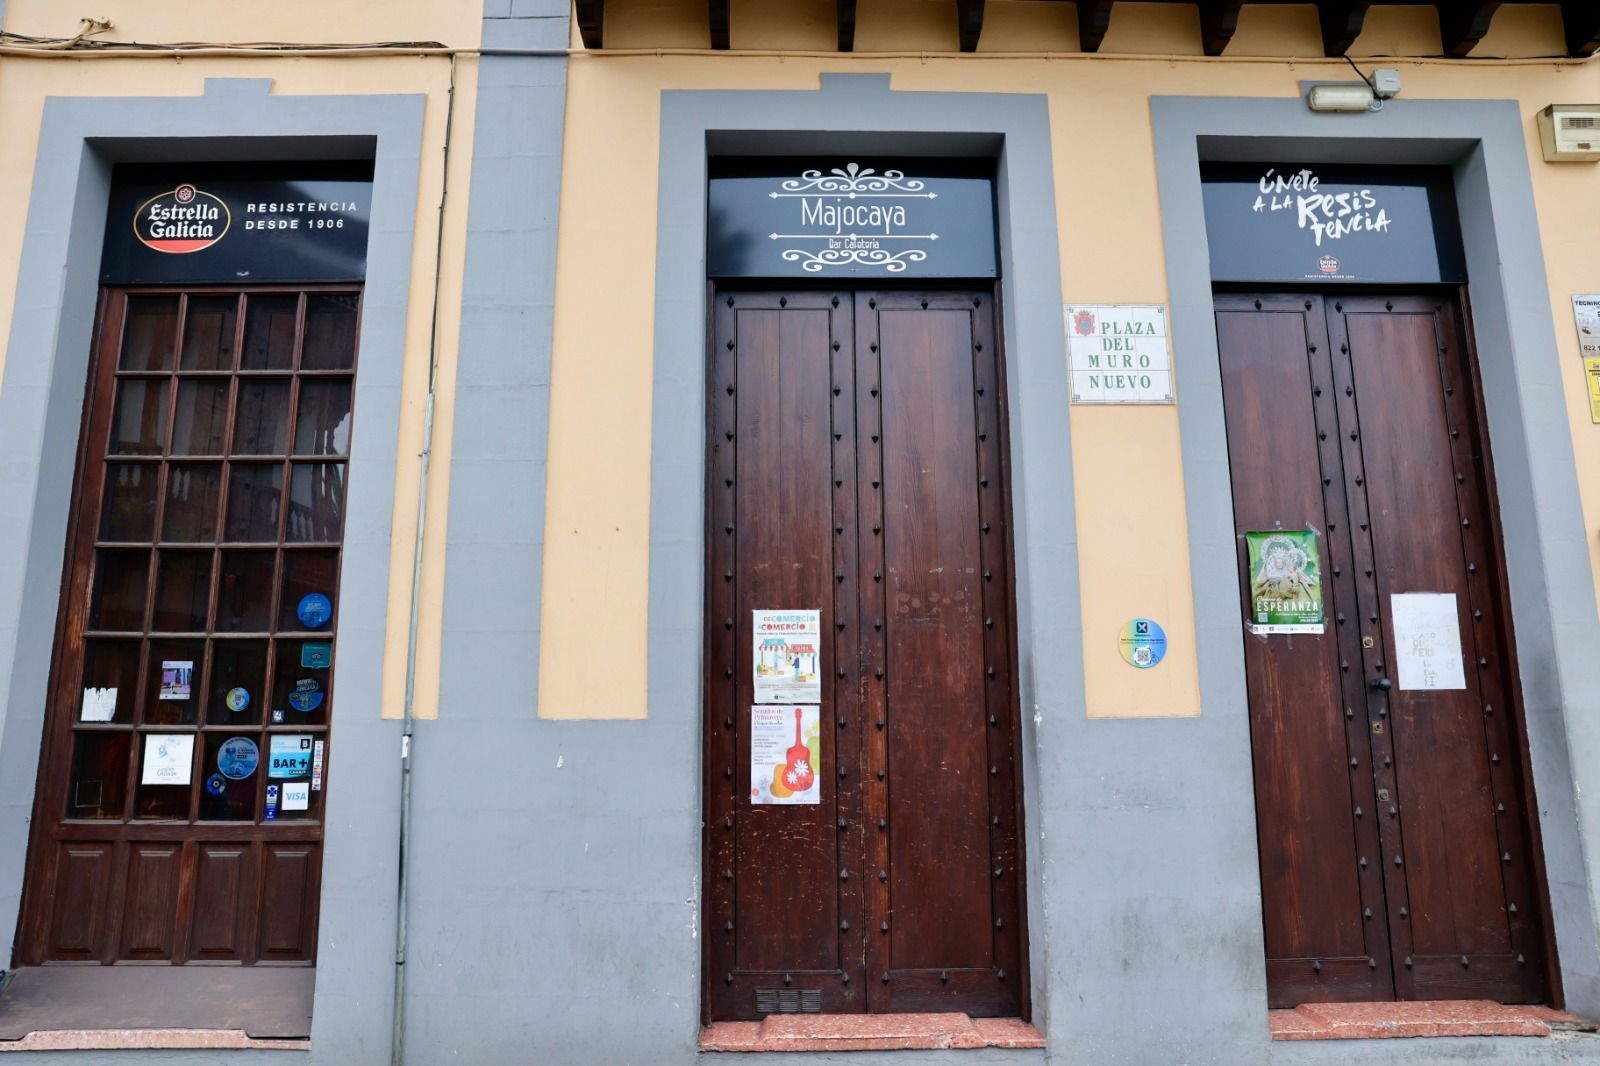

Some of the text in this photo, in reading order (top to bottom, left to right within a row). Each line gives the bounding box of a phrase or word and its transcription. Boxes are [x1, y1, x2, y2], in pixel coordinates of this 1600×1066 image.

[147, 203, 219, 221] Estrella
[247, 202, 357, 213] RESISTENCIA
[801, 197, 906, 235] Majocaya
[149, 220, 214, 239] Galicia
[245, 218, 344, 230] DESDE 1906
[828, 239, 841, 249] Bar
[1101, 321, 1156, 335] PLAZA
[1102, 337, 1134, 351] DEL
[1088, 354, 1150, 368] MURO
[1089, 375, 1151, 389] NUEVO
[1256, 600, 1319, 612] ESPERANZA
[273, 758, 297, 769] BAR
[286, 792, 307, 801] VISA
